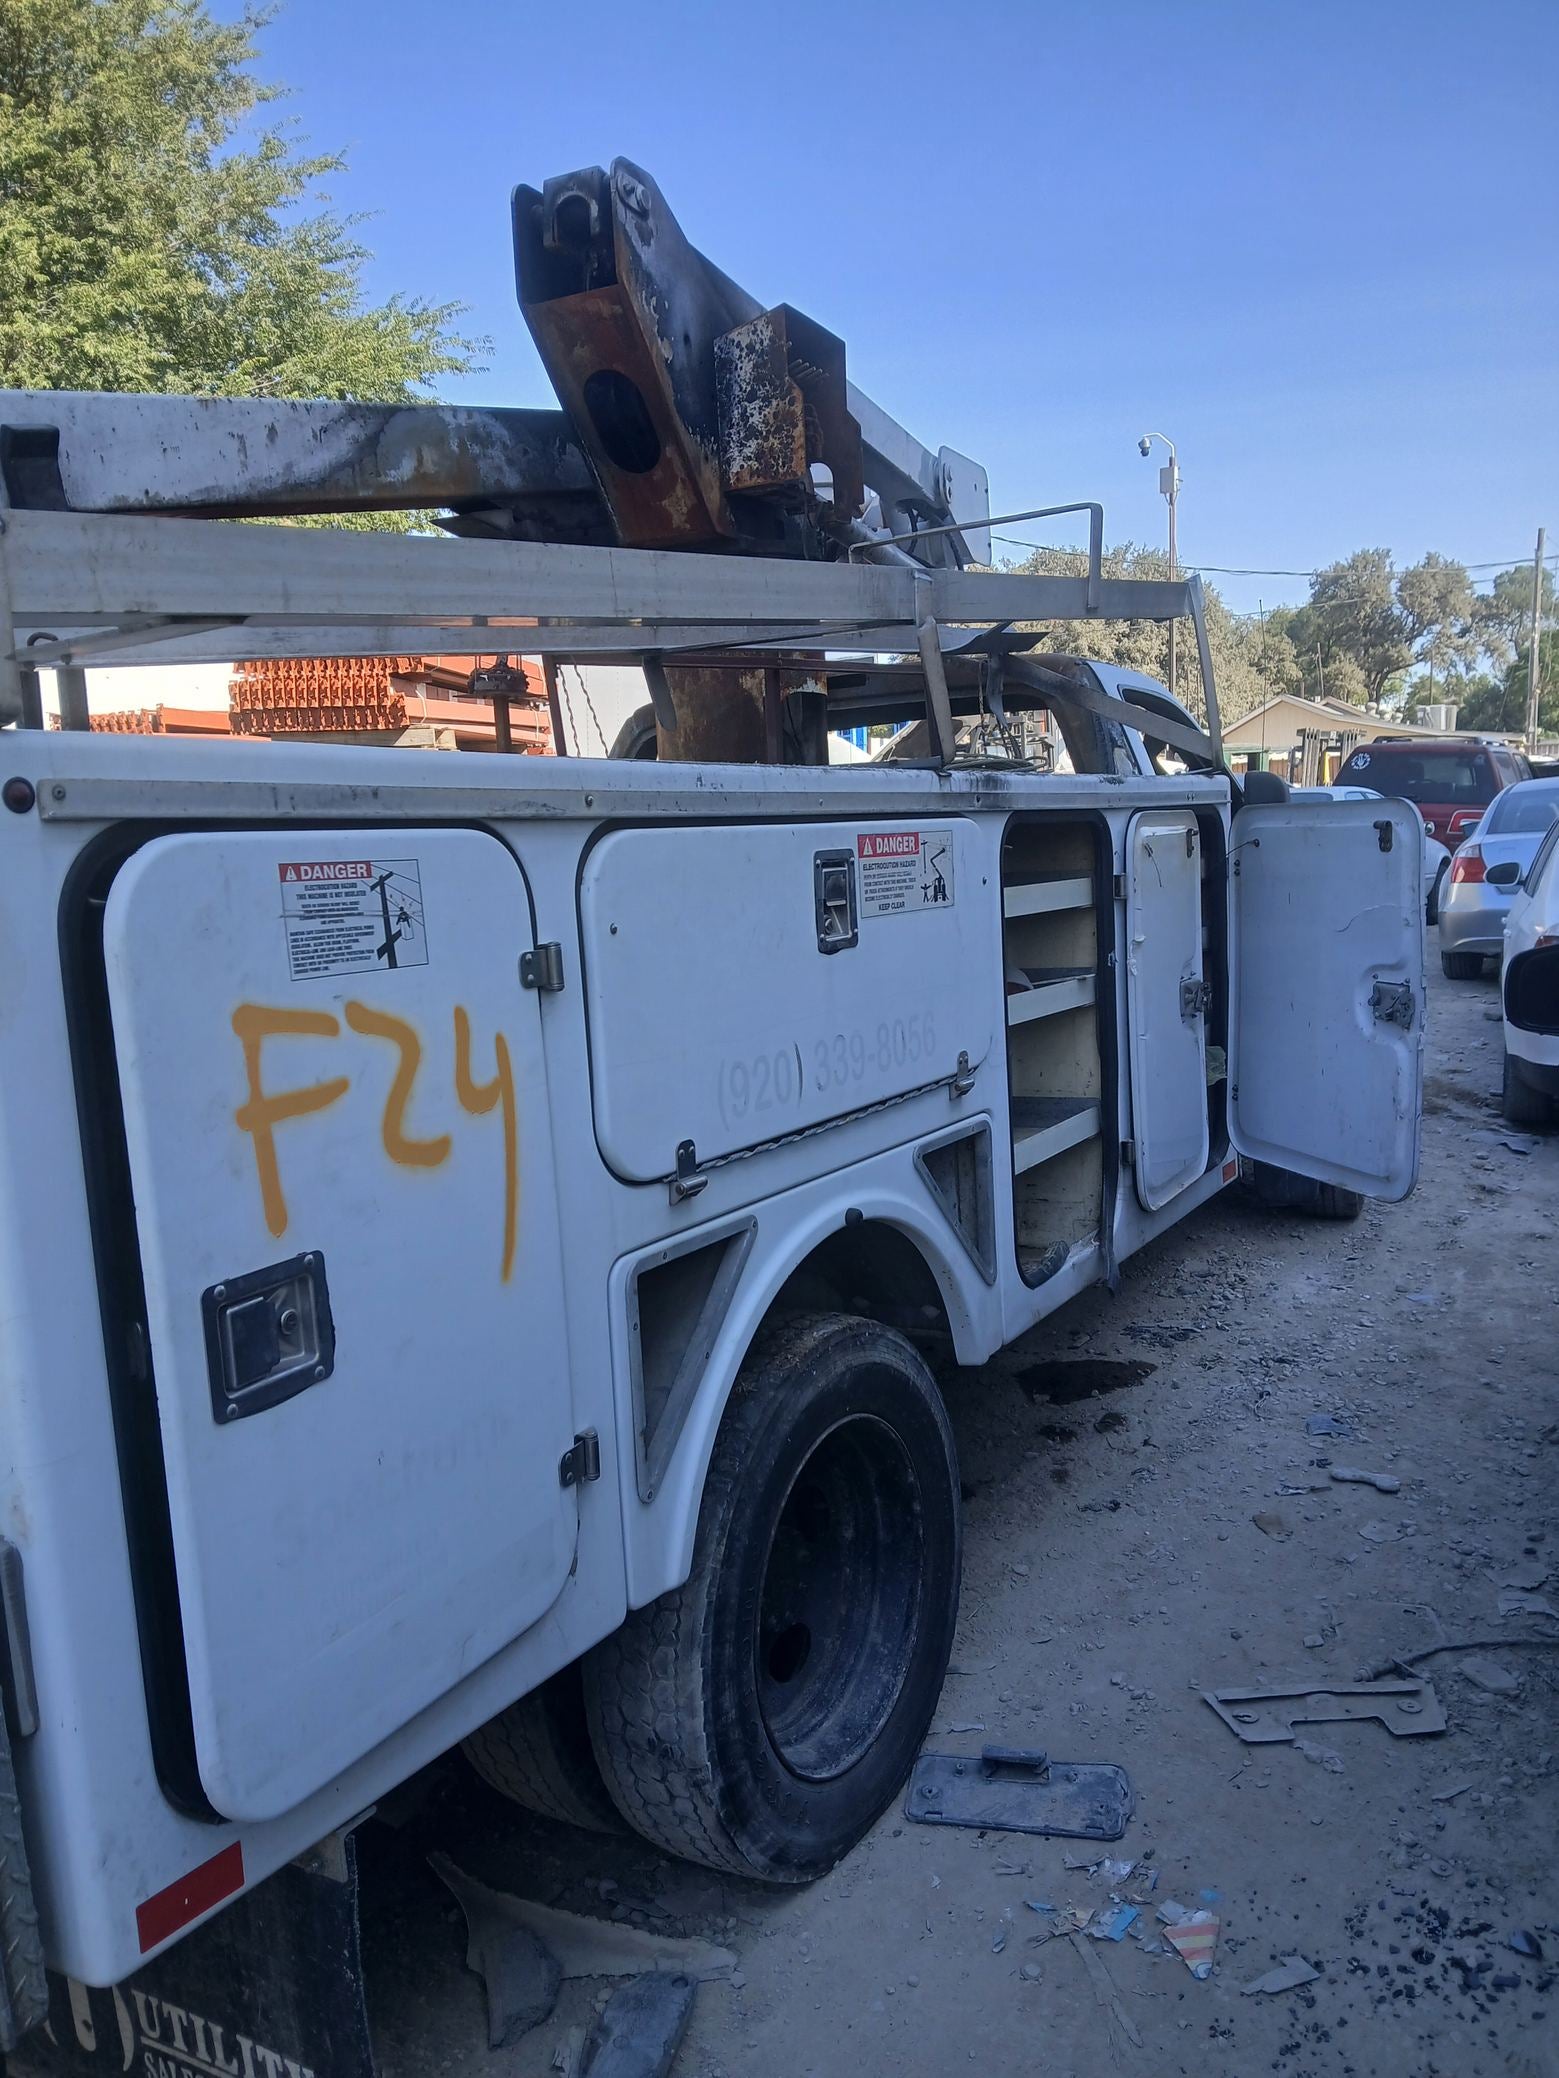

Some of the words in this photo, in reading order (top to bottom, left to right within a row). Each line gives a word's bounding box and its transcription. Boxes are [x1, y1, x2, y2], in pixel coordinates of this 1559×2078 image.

[876, 836, 915, 854] DANGER
[300, 863, 368, 880] DANGER
[879, 903, 890, 911] KEEP
[891, 901, 905, 910] CLEAR
[718, 1040, 803, 1132] (920)
